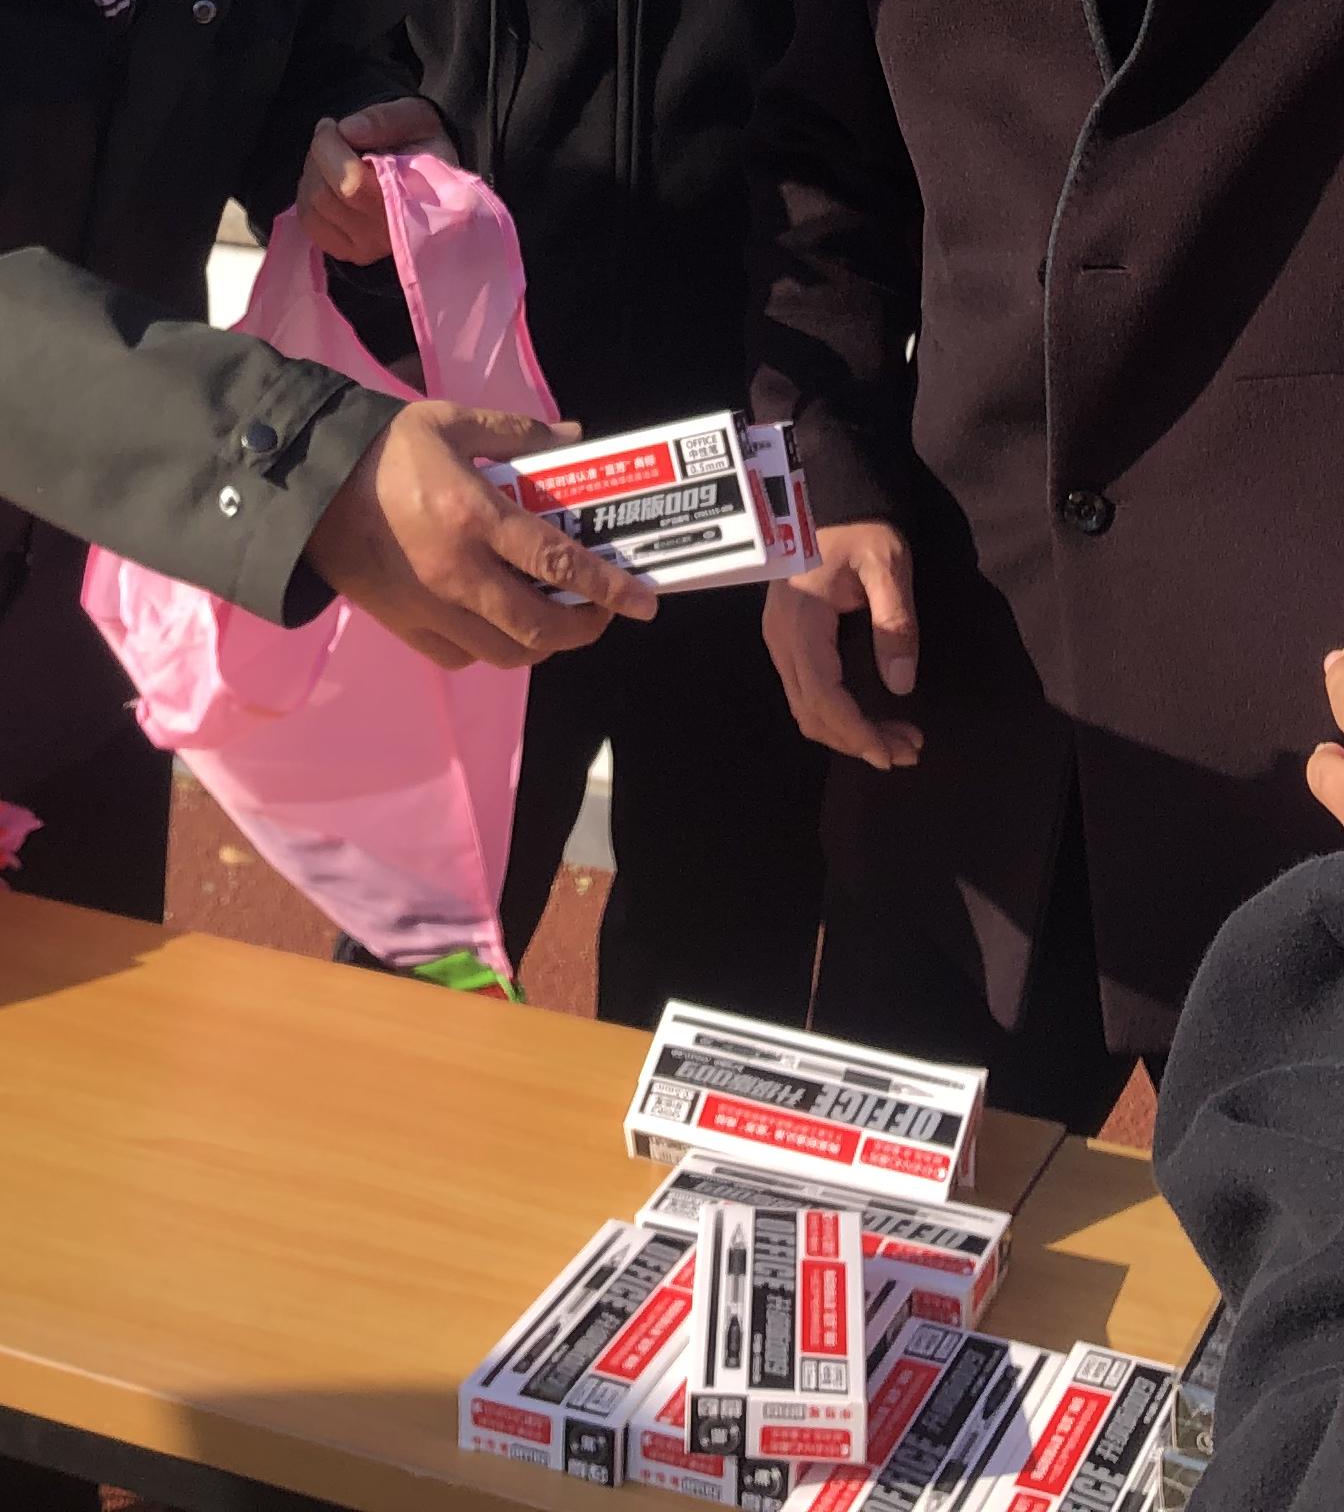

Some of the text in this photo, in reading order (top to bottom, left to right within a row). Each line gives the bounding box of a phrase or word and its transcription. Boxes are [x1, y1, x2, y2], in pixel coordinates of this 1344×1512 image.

[592, 483, 719, 534] 升级版009
[809, 1087, 942, 1141] OFFICE
